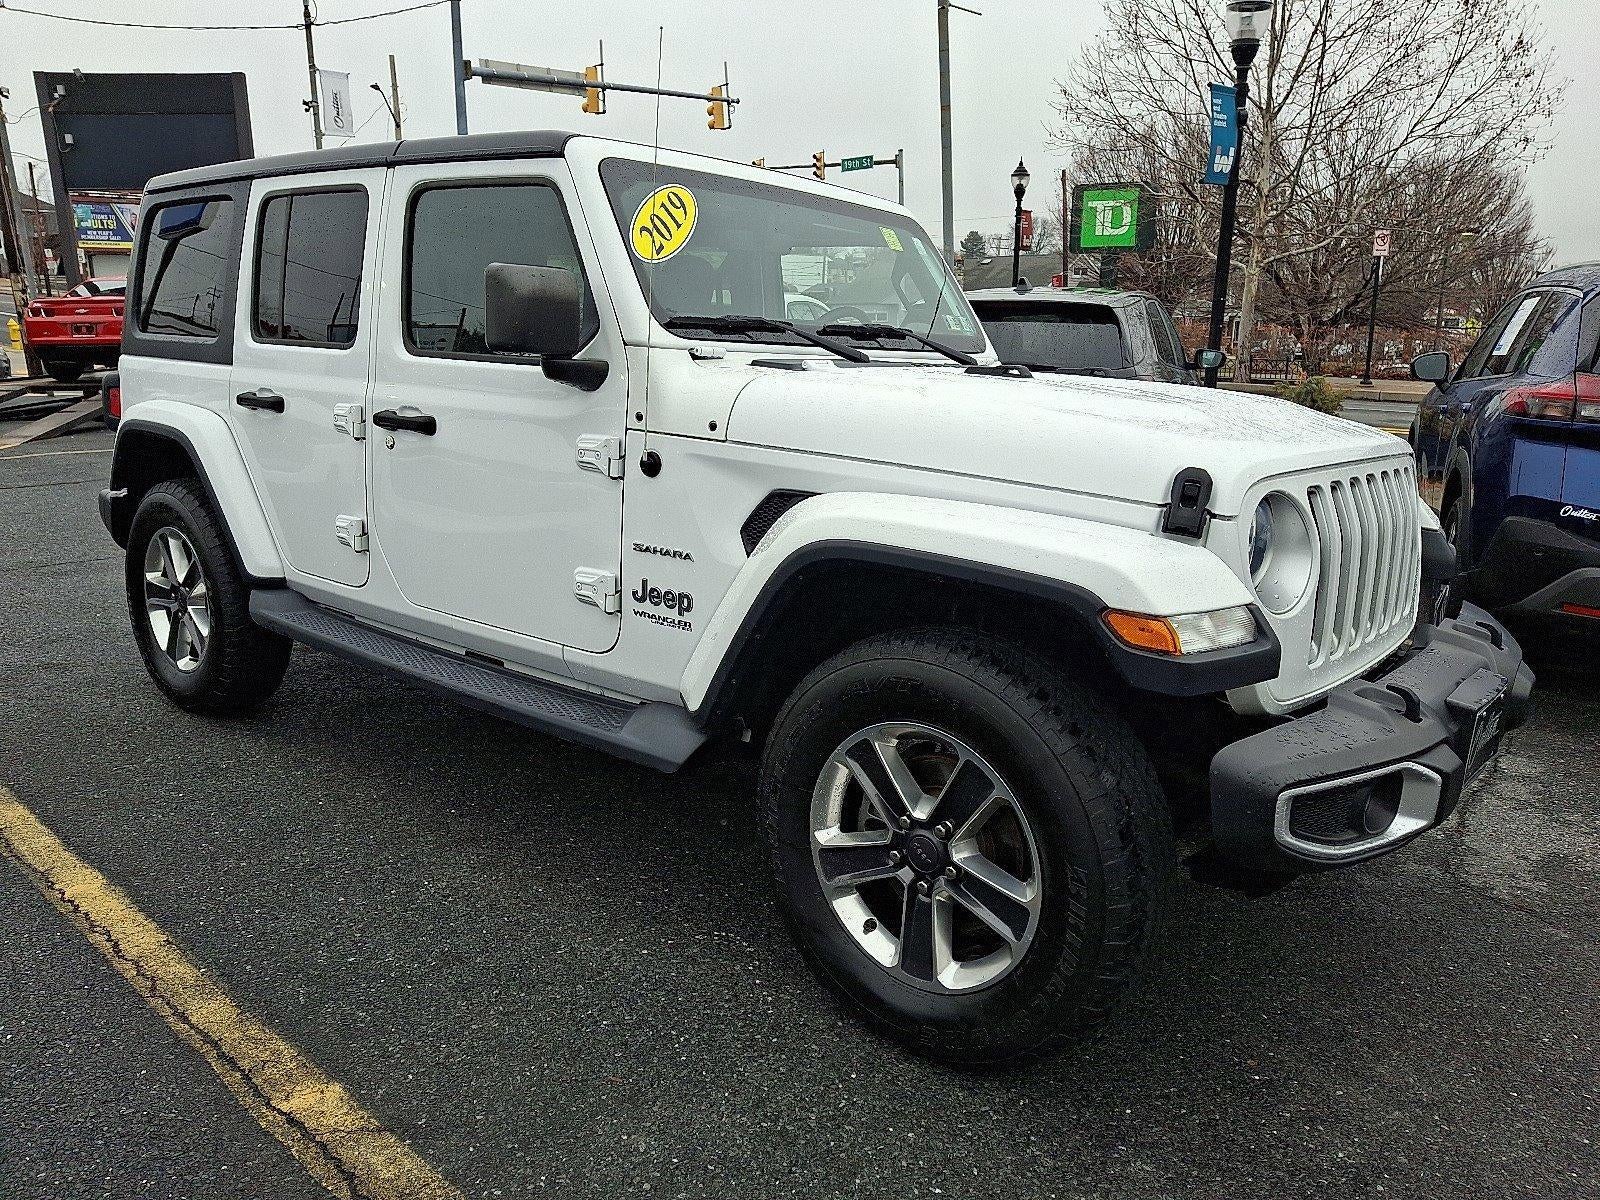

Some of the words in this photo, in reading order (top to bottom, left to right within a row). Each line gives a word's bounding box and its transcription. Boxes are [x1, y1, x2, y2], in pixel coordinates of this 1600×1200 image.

[844, 160, 860, 169] 19th
[862, 158, 871, 167] St
[640, 191, 687, 256] 2019
[1088, 200, 1132, 236] TD
[632, 542, 695, 563] SAHARA
[631, 577, 694, 617] Jeep
[632, 608, 692, 629] WRANGLER
[650, 619, 693, 632] UNLIMITED
